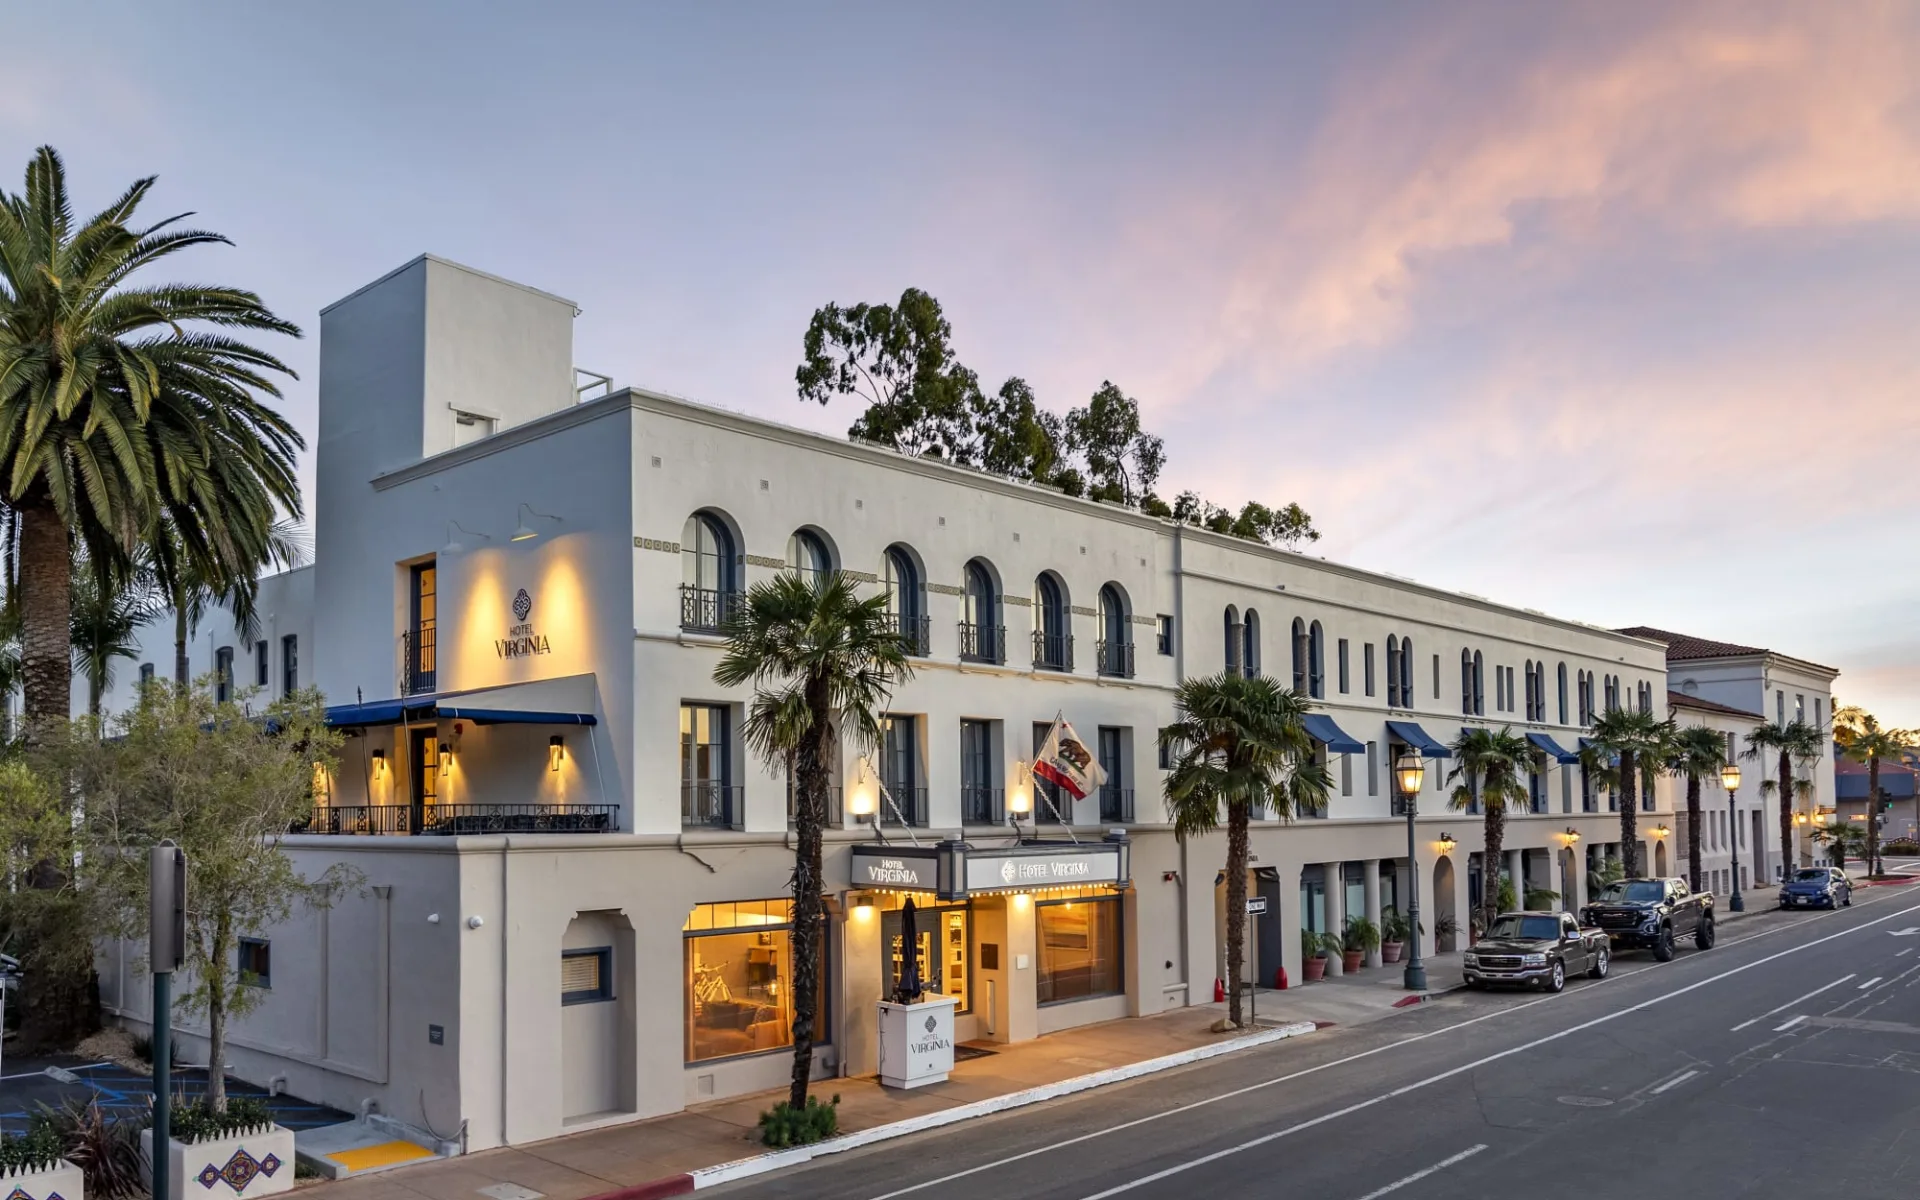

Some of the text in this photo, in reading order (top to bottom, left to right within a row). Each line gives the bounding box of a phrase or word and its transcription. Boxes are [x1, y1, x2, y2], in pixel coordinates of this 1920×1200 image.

[509, 623, 534, 636] HOTEL
[495, 634, 551, 659] VIRGINIA
[882, 860, 904, 870] HOTEL
[1019, 861, 1089, 878] HOTEL VIRGINIA
[868, 866, 918, 883] VIRGINIA
[922, 1033, 939, 1041] HOTEL
[911, 1039, 950, 1054] VIRGINIA
